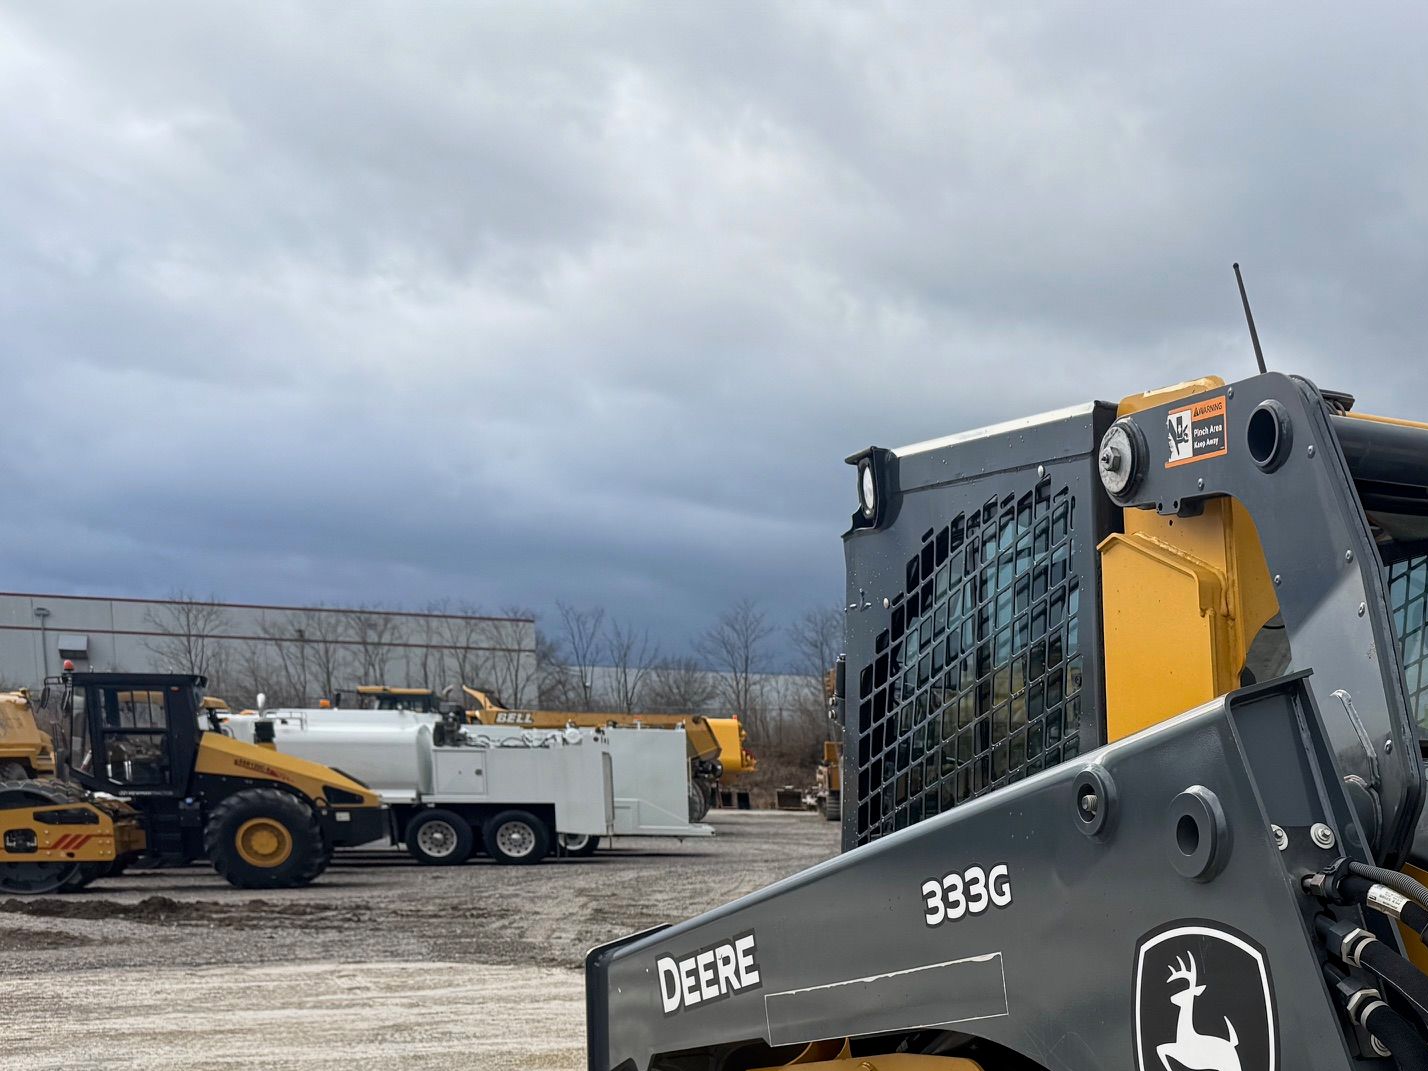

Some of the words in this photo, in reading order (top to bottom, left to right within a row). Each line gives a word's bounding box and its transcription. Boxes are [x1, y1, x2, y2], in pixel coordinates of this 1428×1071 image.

[1198, 402, 1223, 415] WARNING
[1193, 426, 1209, 438] Pinch
[1210, 424, 1223, 434] Area
[1193, 440, 1206, 449] Keep
[1206, 437, 1219, 446] Away
[496, 712, 533, 723] BELL
[922, 864, 1012, 925] 333G
[657, 934, 760, 1013] DEERE
